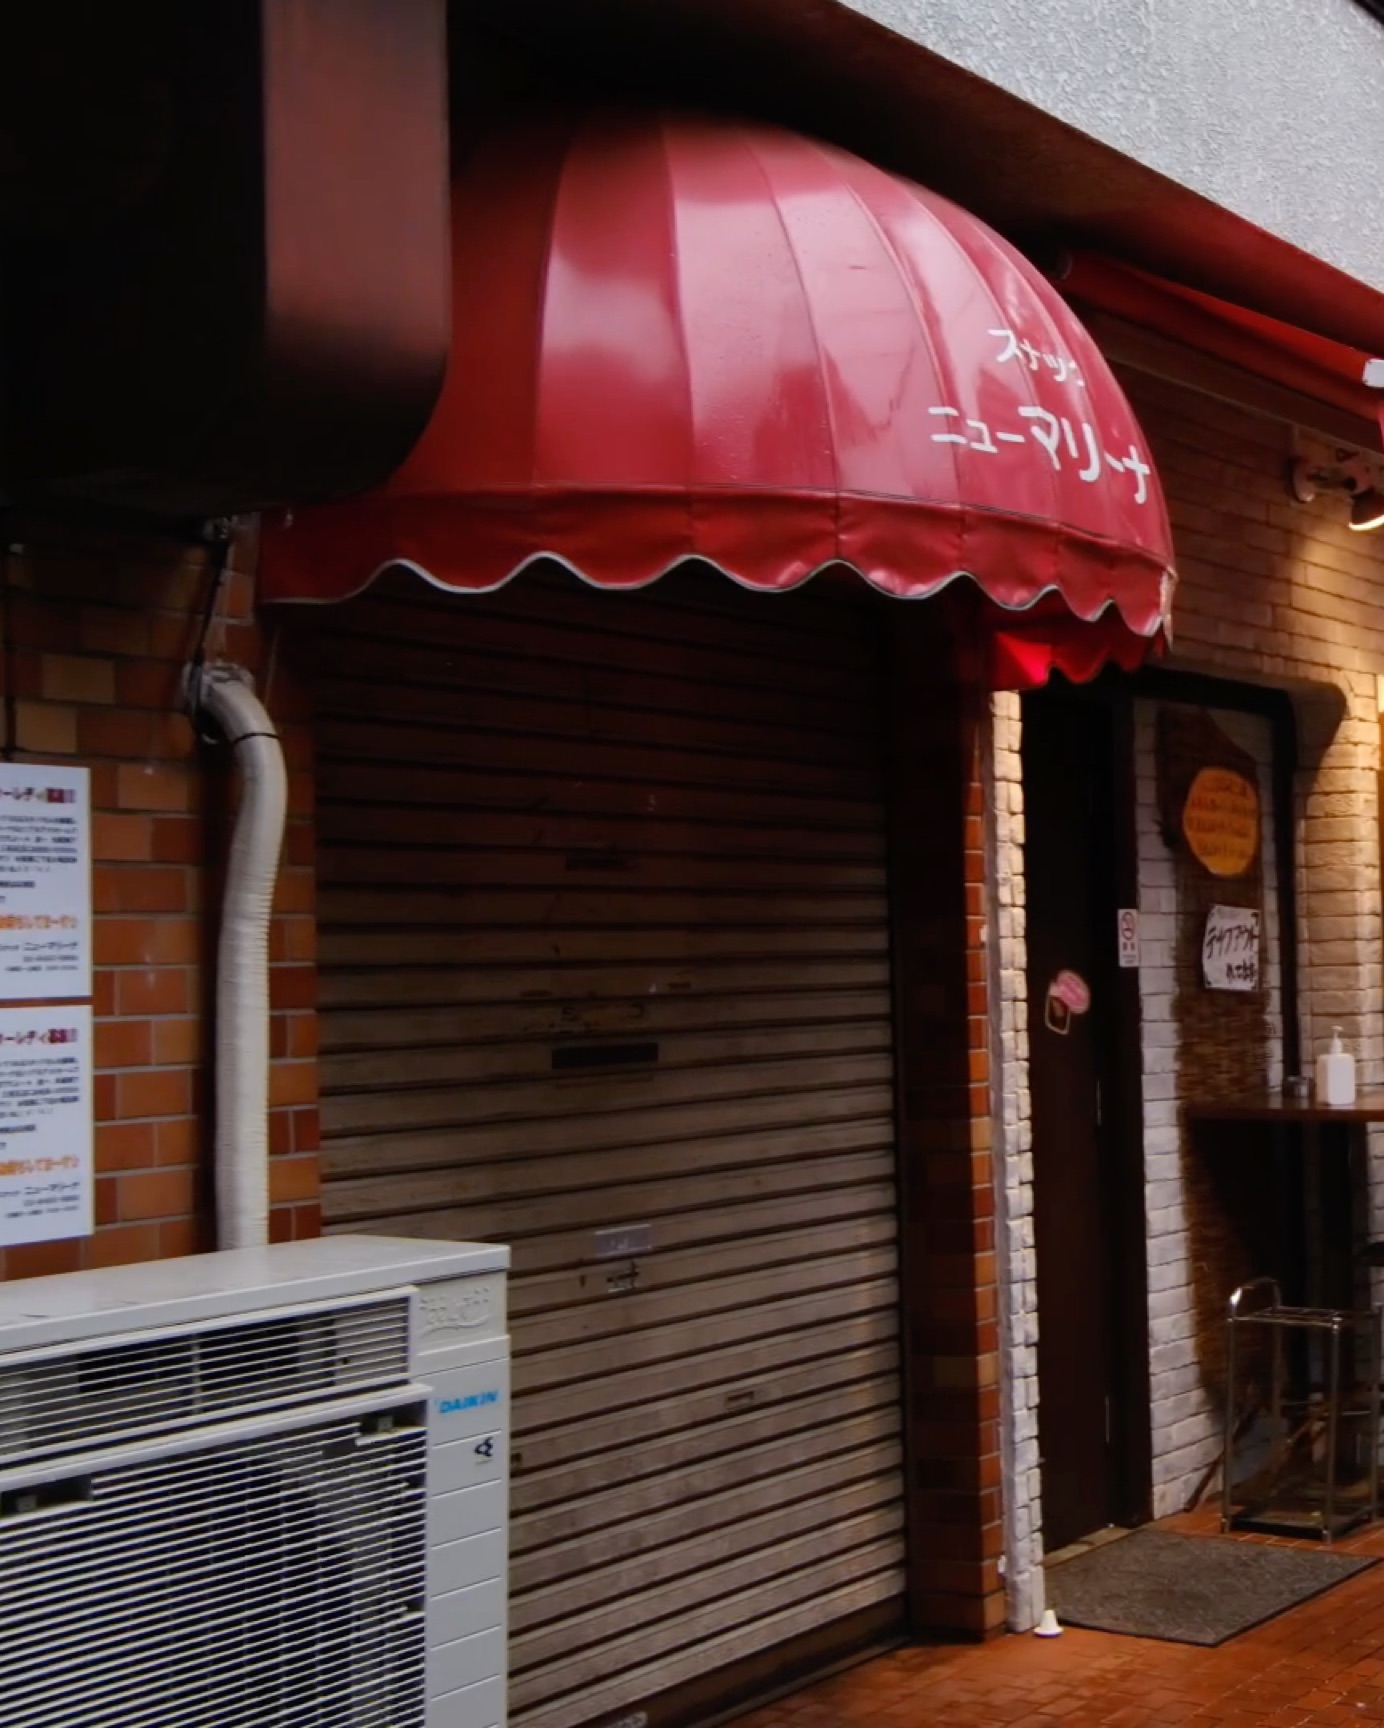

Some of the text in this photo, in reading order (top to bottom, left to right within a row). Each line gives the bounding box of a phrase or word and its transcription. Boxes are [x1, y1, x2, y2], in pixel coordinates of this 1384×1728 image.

[928, 405, 1151, 505] ニューマリーナ
[439, 1391, 499, 1414] DAIKIN
